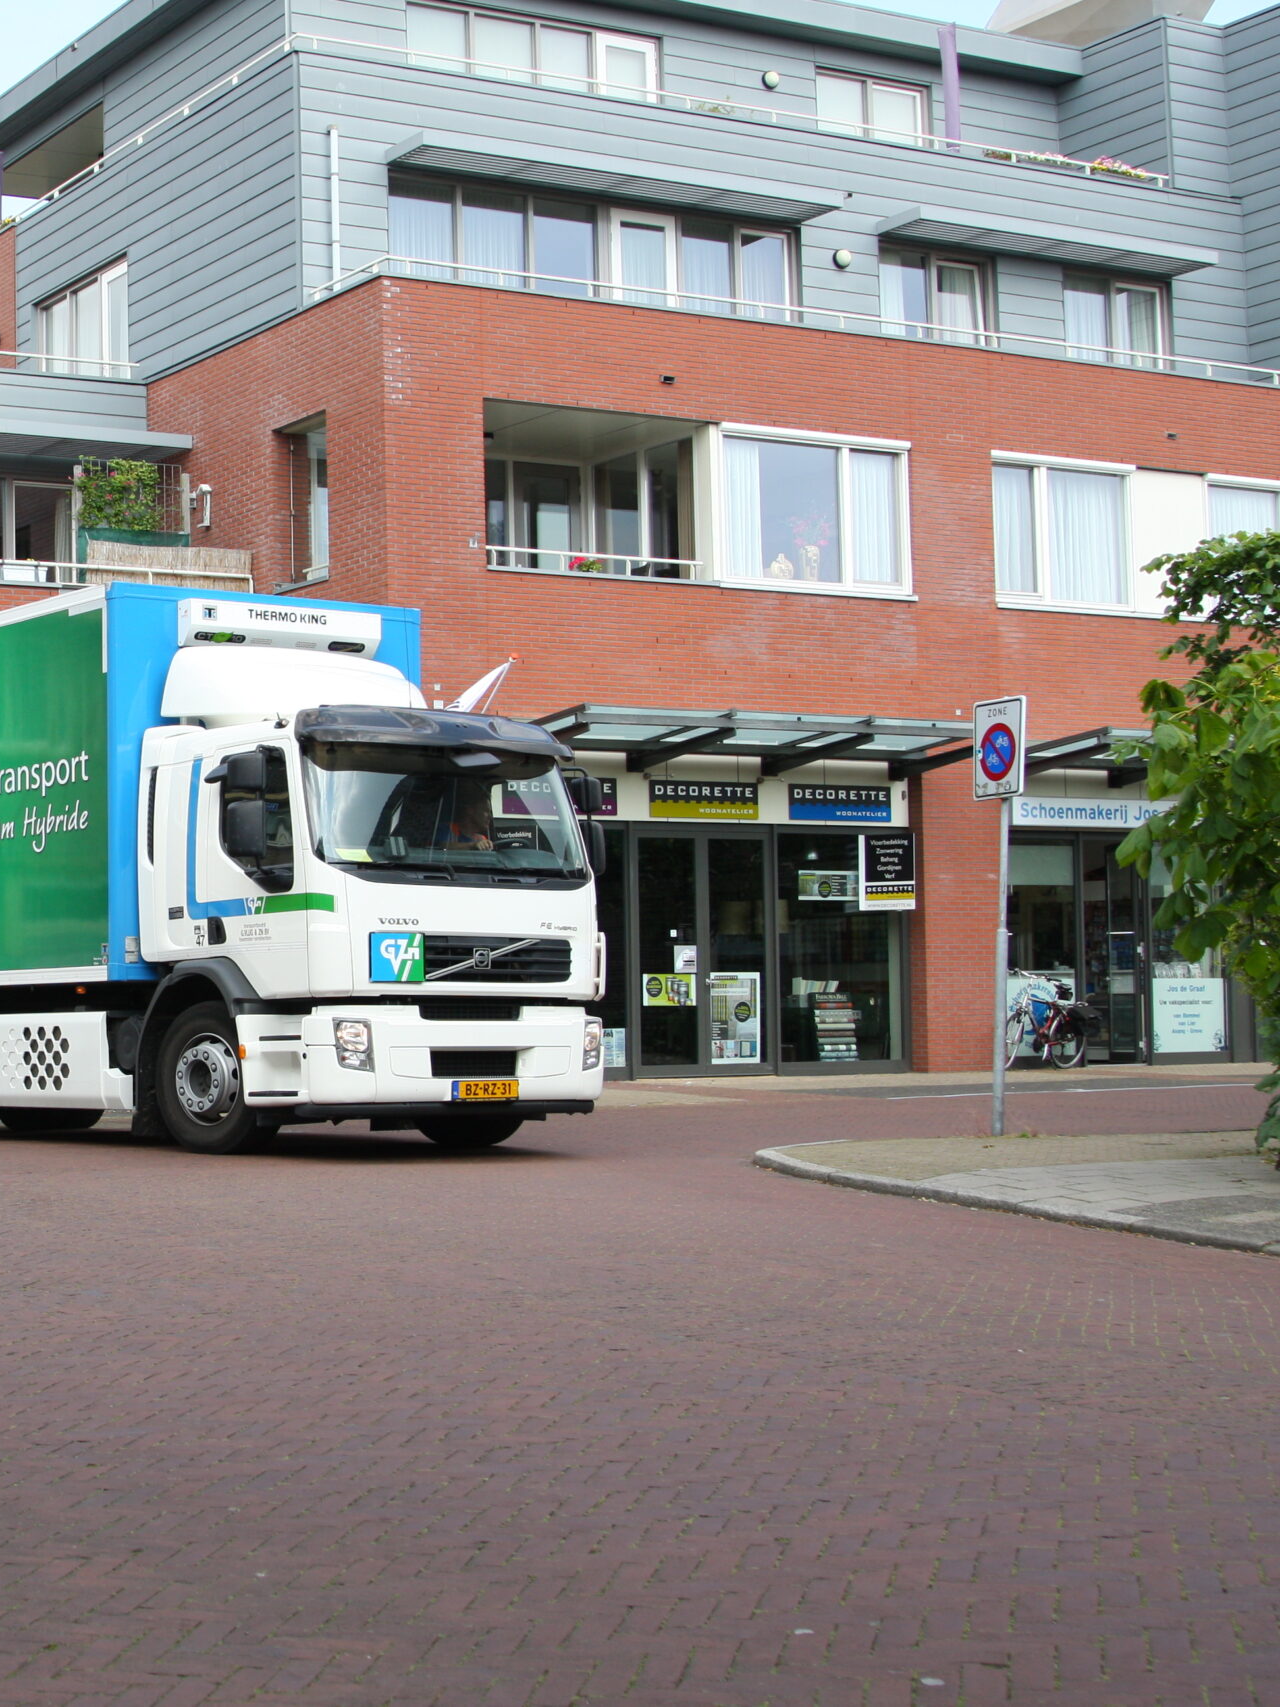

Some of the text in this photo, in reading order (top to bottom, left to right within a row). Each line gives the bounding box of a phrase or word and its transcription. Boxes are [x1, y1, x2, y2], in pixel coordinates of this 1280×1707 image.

[248, 609, 327, 625] THERMO KING
[987, 706, 1008, 718] ZONE
[654, 785, 754, 798] DECORETTE
[793, 788, 887, 801] DECORETTE
[1020, 802, 1159, 824] Schoenmakerij Jos
[22, 799, 89, 853] Hybride
[870, 838, 908, 846] Vloerbedekking
[377, 917, 419, 926] VOLVO
[196, 934, 205, 947] 47
[465, 1083, 512, 1096] BZ-RZ-31
